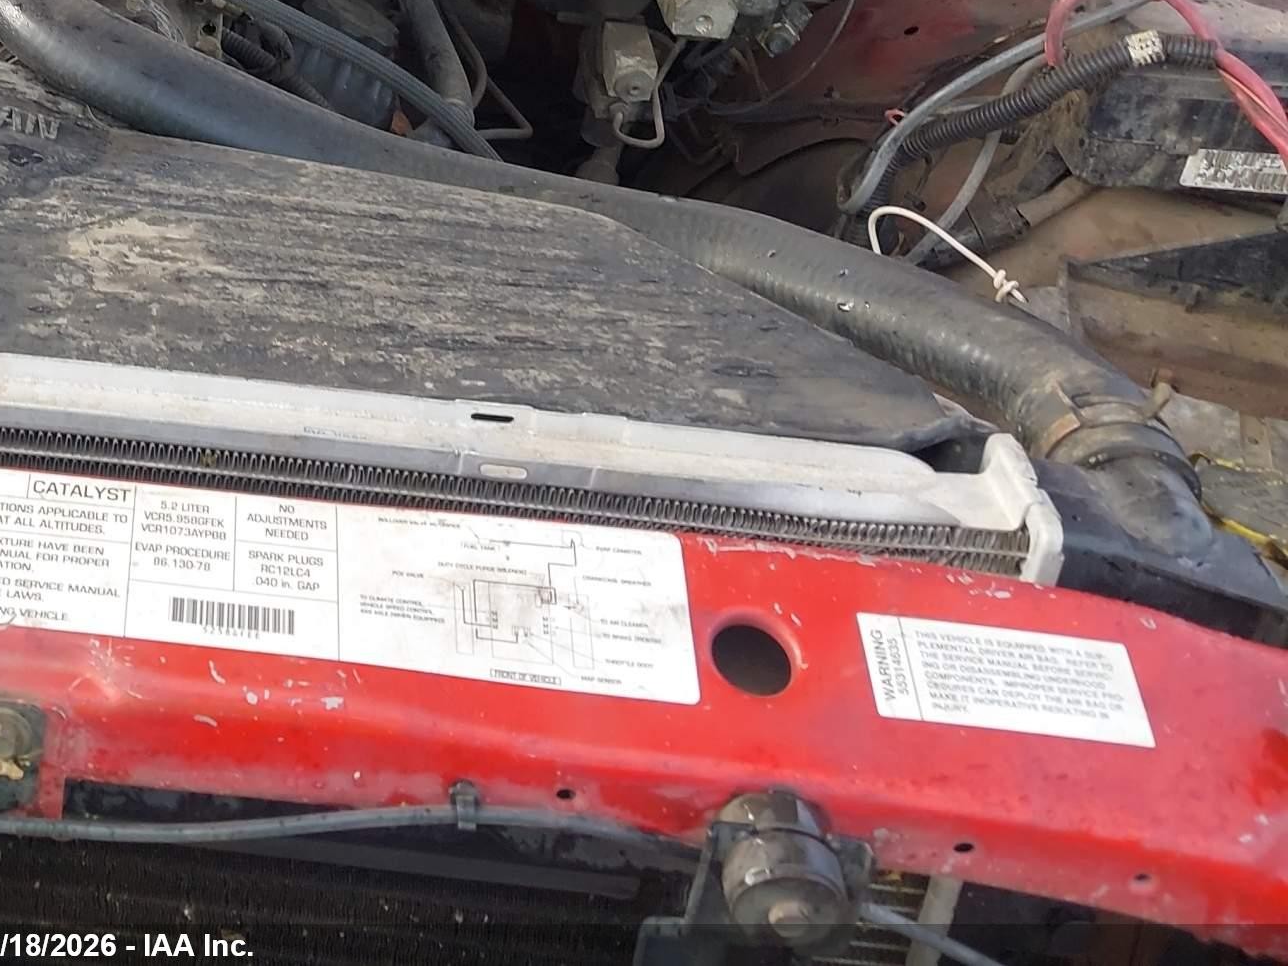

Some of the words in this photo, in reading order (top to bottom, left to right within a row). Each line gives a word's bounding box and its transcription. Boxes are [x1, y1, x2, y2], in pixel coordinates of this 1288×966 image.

[33, 480, 131, 502] CATALYST
[161, 500, 178, 511] 5.2
[181, 502, 210, 514] LITER
[279, 504, 295, 514] NO
[14, 516, 35, 527] ALL
[38, 506, 109, 521] APPLICABLE
[113, 513, 128, 524] TO
[247, 513, 327, 530] ADJUSTMENTS
[265, 528, 309, 541] NEEDED
[38, 541, 68, 552] HAVE
[73, 544, 104, 555] BEEN
[135, 542, 162, 555] EVAP
[166, 546, 230, 561] PROCEDURE
[36, 552, 58, 562] FOR
[63, 555, 109, 567] PROPER
[249, 550, 284, 562] SPARK
[288, 555, 323, 567] PLUGS
[15, 578, 63, 592] SERVICE
[297, 580, 320, 591] GAP
[20, 608, 69, 621] VEHICLE
[940, 632, 980, 644] VEHICLE
[871, 629, 896, 701] WARNING
